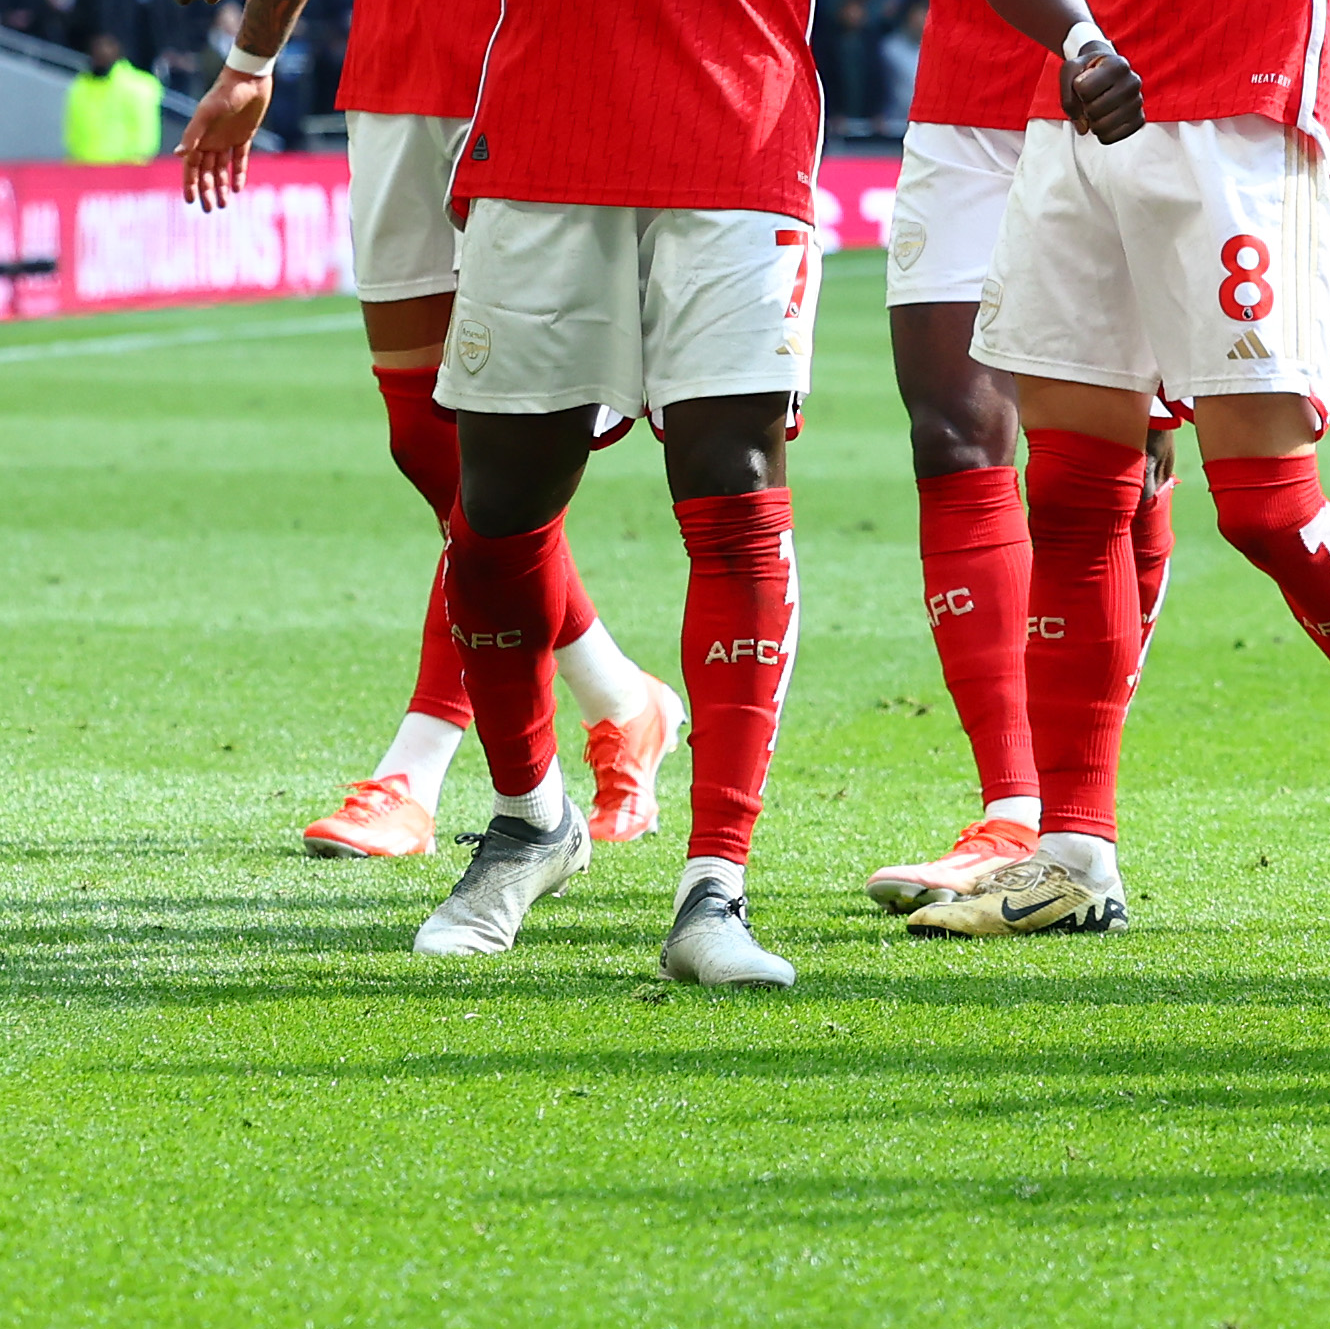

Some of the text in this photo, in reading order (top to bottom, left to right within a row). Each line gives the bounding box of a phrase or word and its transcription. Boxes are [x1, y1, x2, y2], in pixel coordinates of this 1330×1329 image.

[775, 229, 810, 319] 7
[1218, 233, 1275, 322] 8
[451, 623, 522, 649] AFC
[1027, 616, 1066, 640] FC
[704, 638, 780, 666] AFC
